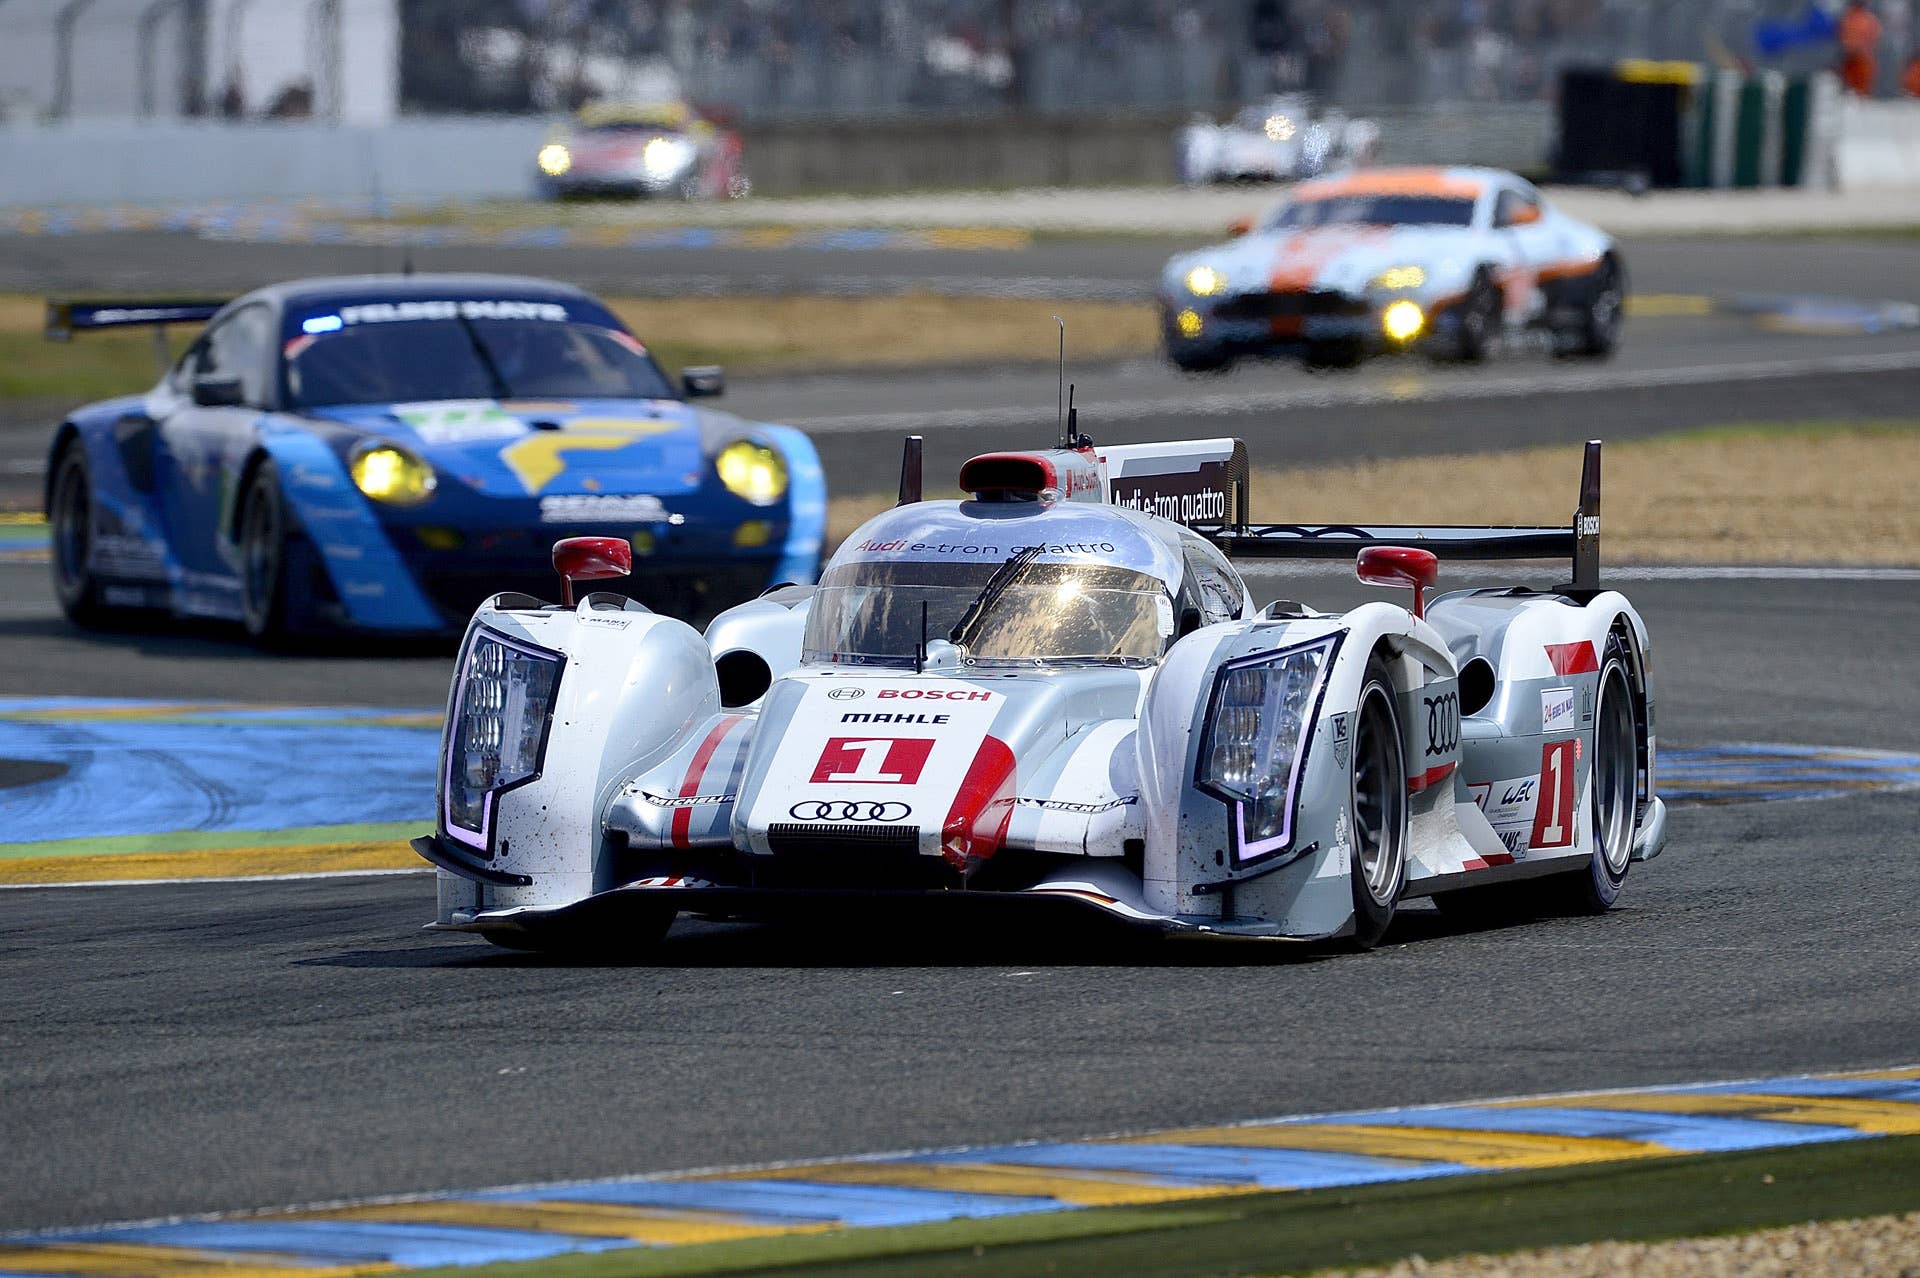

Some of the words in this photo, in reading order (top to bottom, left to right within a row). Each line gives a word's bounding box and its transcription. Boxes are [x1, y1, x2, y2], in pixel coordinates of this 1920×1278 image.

[1144, 491, 1179, 521] e-tron
[1182, 487, 1225, 527] quattro
[856, 539, 908, 553] Audi
[911, 542, 998, 554] e-tron
[1010, 541, 1115, 555] qattro
[877, 689, 992, 702] BOSCH
[840, 712, 951, 725] MAHLE
[1544, 703, 1552, 724] 24
[827, 739, 903, 782] 1
[1501, 780, 1535, 805] WEC
[1542, 746, 1563, 843] 1
[1041, 795, 1136, 813] MICHELIN
